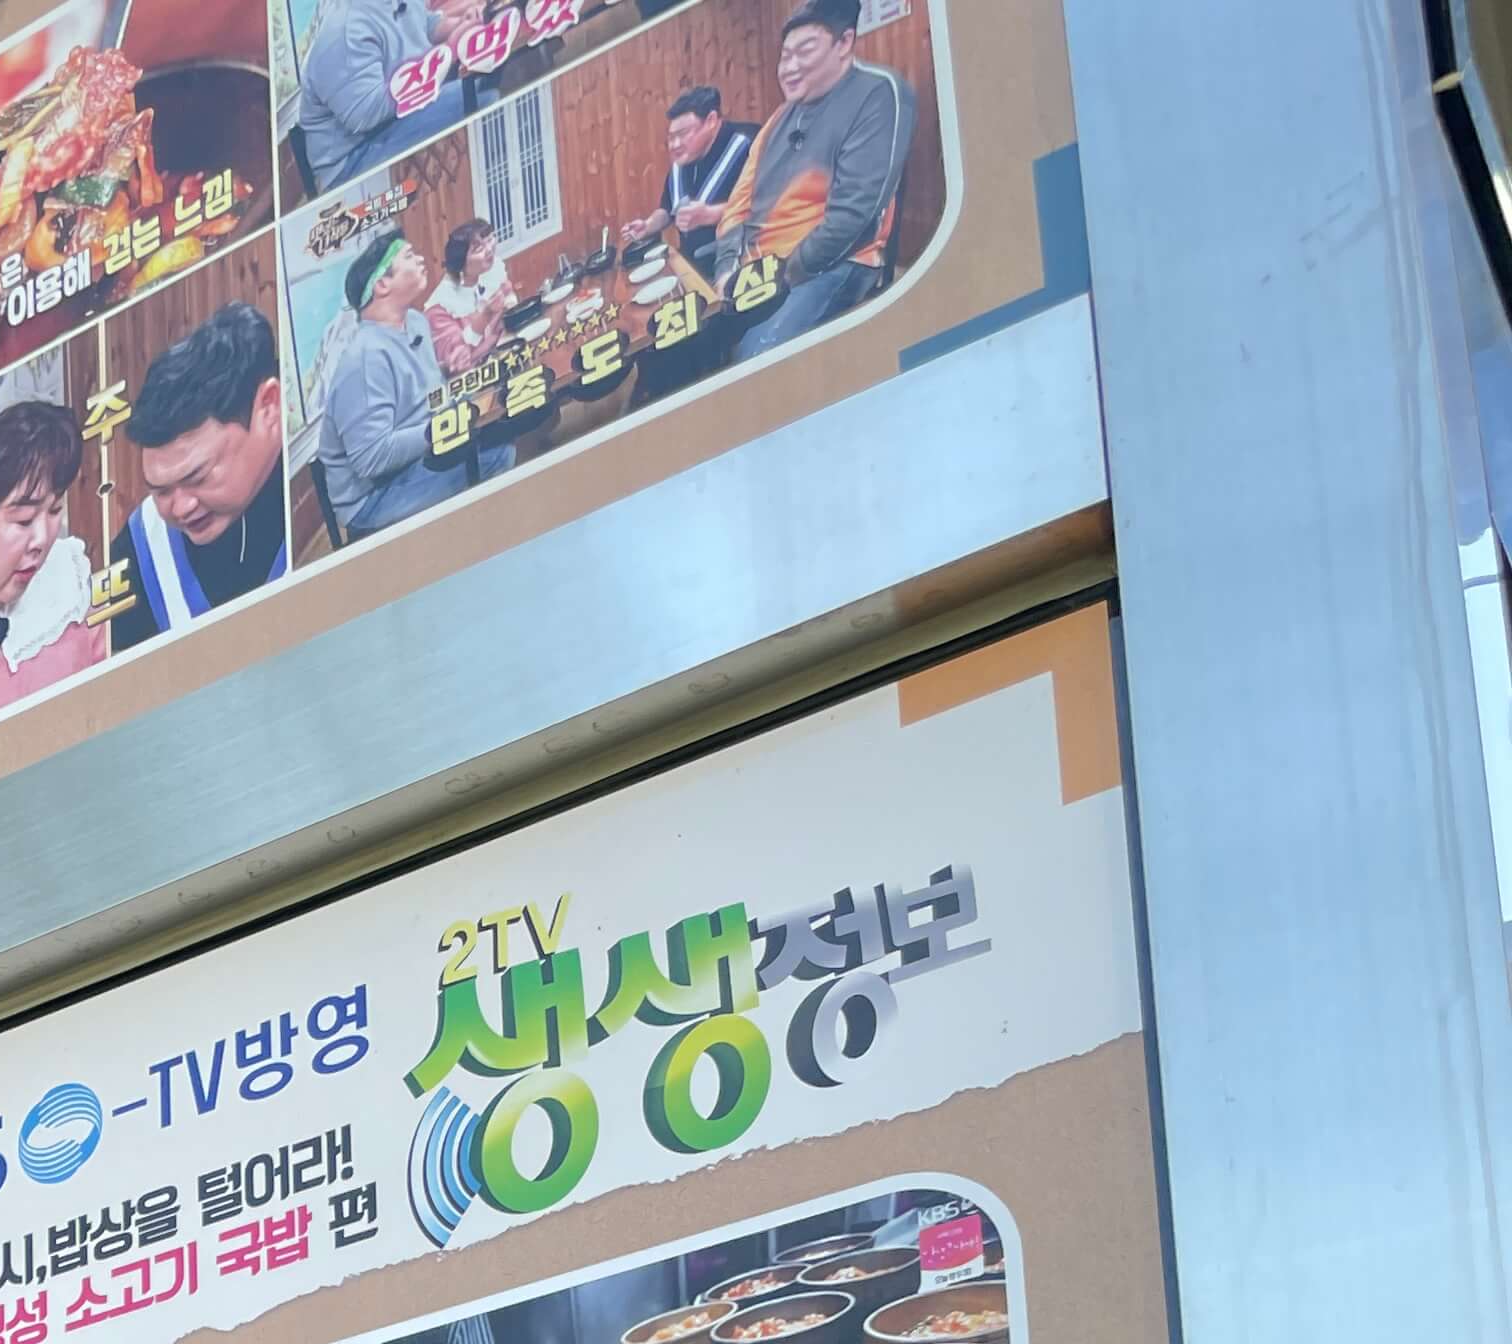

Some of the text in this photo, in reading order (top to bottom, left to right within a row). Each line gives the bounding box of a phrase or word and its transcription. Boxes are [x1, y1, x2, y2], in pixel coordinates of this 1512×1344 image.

[5, 245, 92, 327] 이용해
[102, 214, 162, 276] 걷는
[173, 168, 234, 238] 느낌
[437, 891, 574, 985] 2TV
[403, 862, 993, 1216] 생생정보
[197, 1123, 354, 1228] 털어라!
[64, 1241, 199, 1333] 소고기
[215, 1204, 313, 1279] 국밥
[327, 1180, 380, 1250] 편
